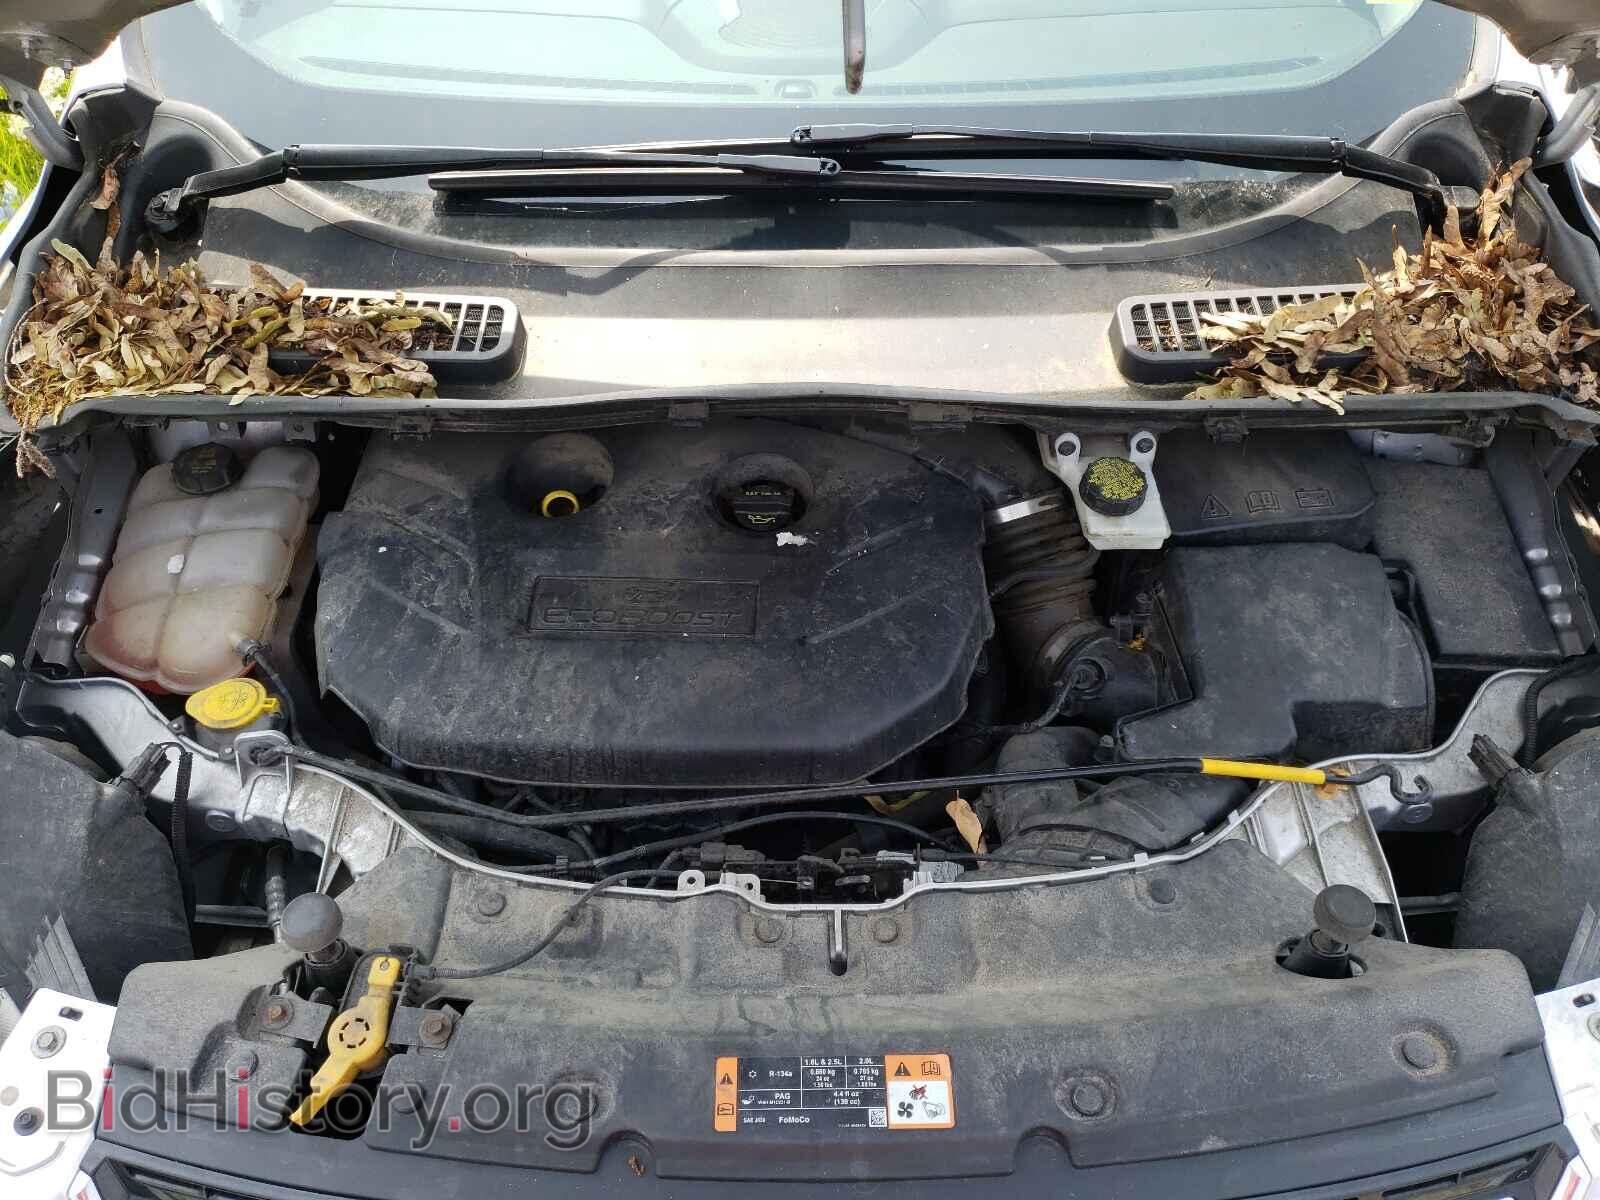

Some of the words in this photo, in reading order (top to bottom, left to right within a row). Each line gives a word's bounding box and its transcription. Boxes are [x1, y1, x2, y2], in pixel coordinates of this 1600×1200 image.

[543, 608, 743, 627] ECOBOOST
[774, 1092, 791, 1100] PAG
[778, 1116, 810, 1124] FoMoCo
